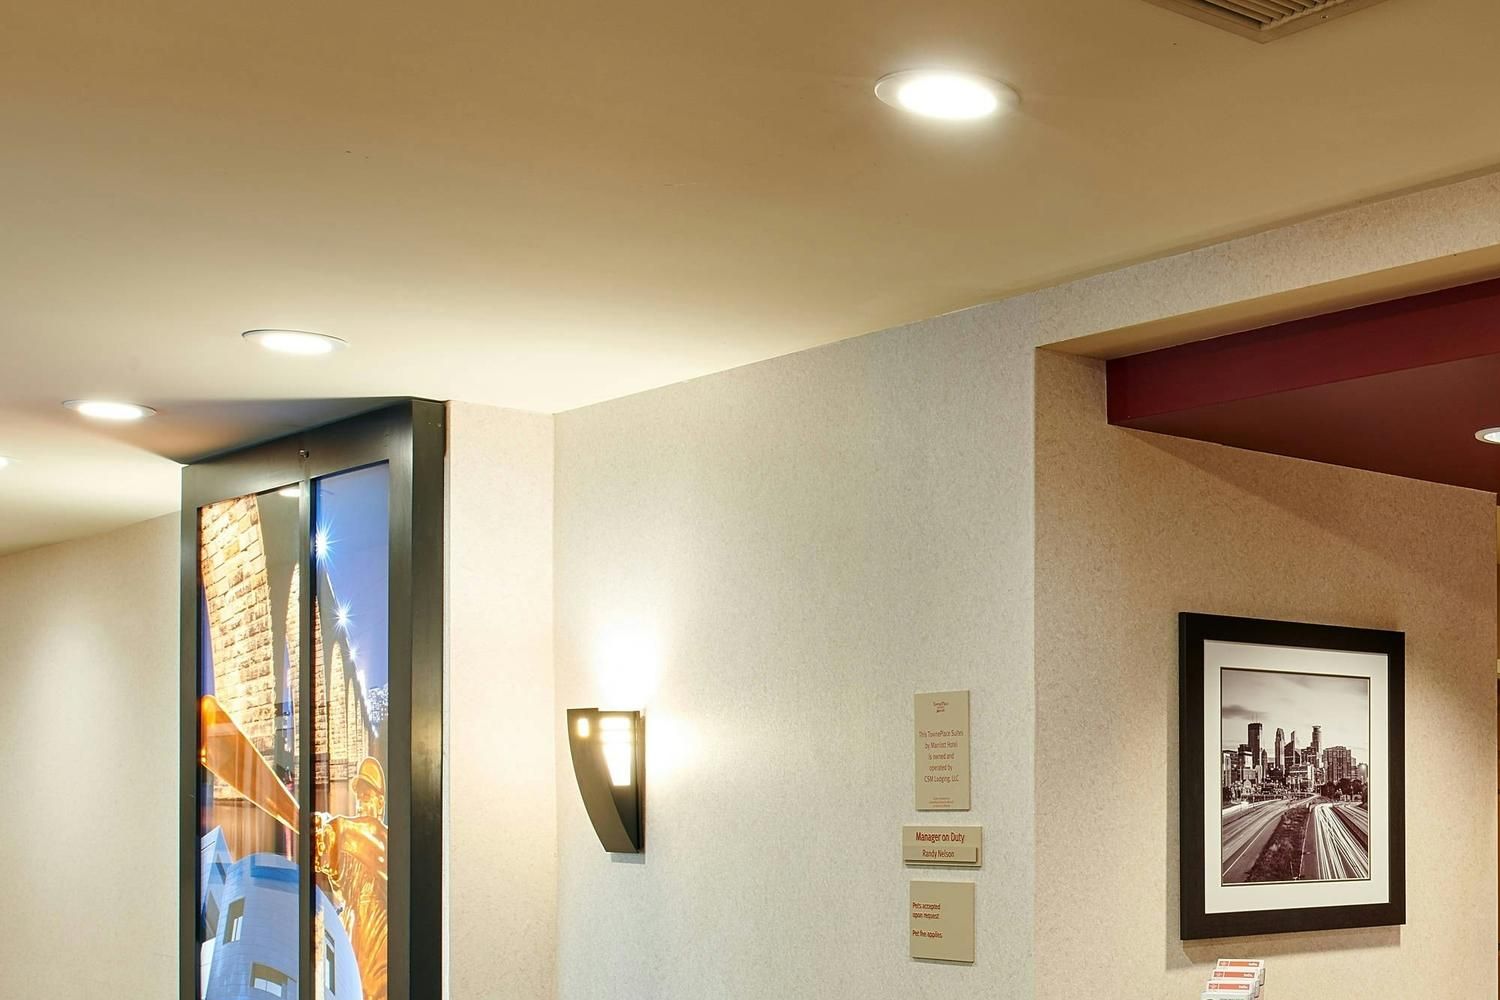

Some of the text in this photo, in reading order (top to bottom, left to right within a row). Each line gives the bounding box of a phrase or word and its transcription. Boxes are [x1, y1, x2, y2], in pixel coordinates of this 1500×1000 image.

[915, 832, 965, 844] Manager on Duty
